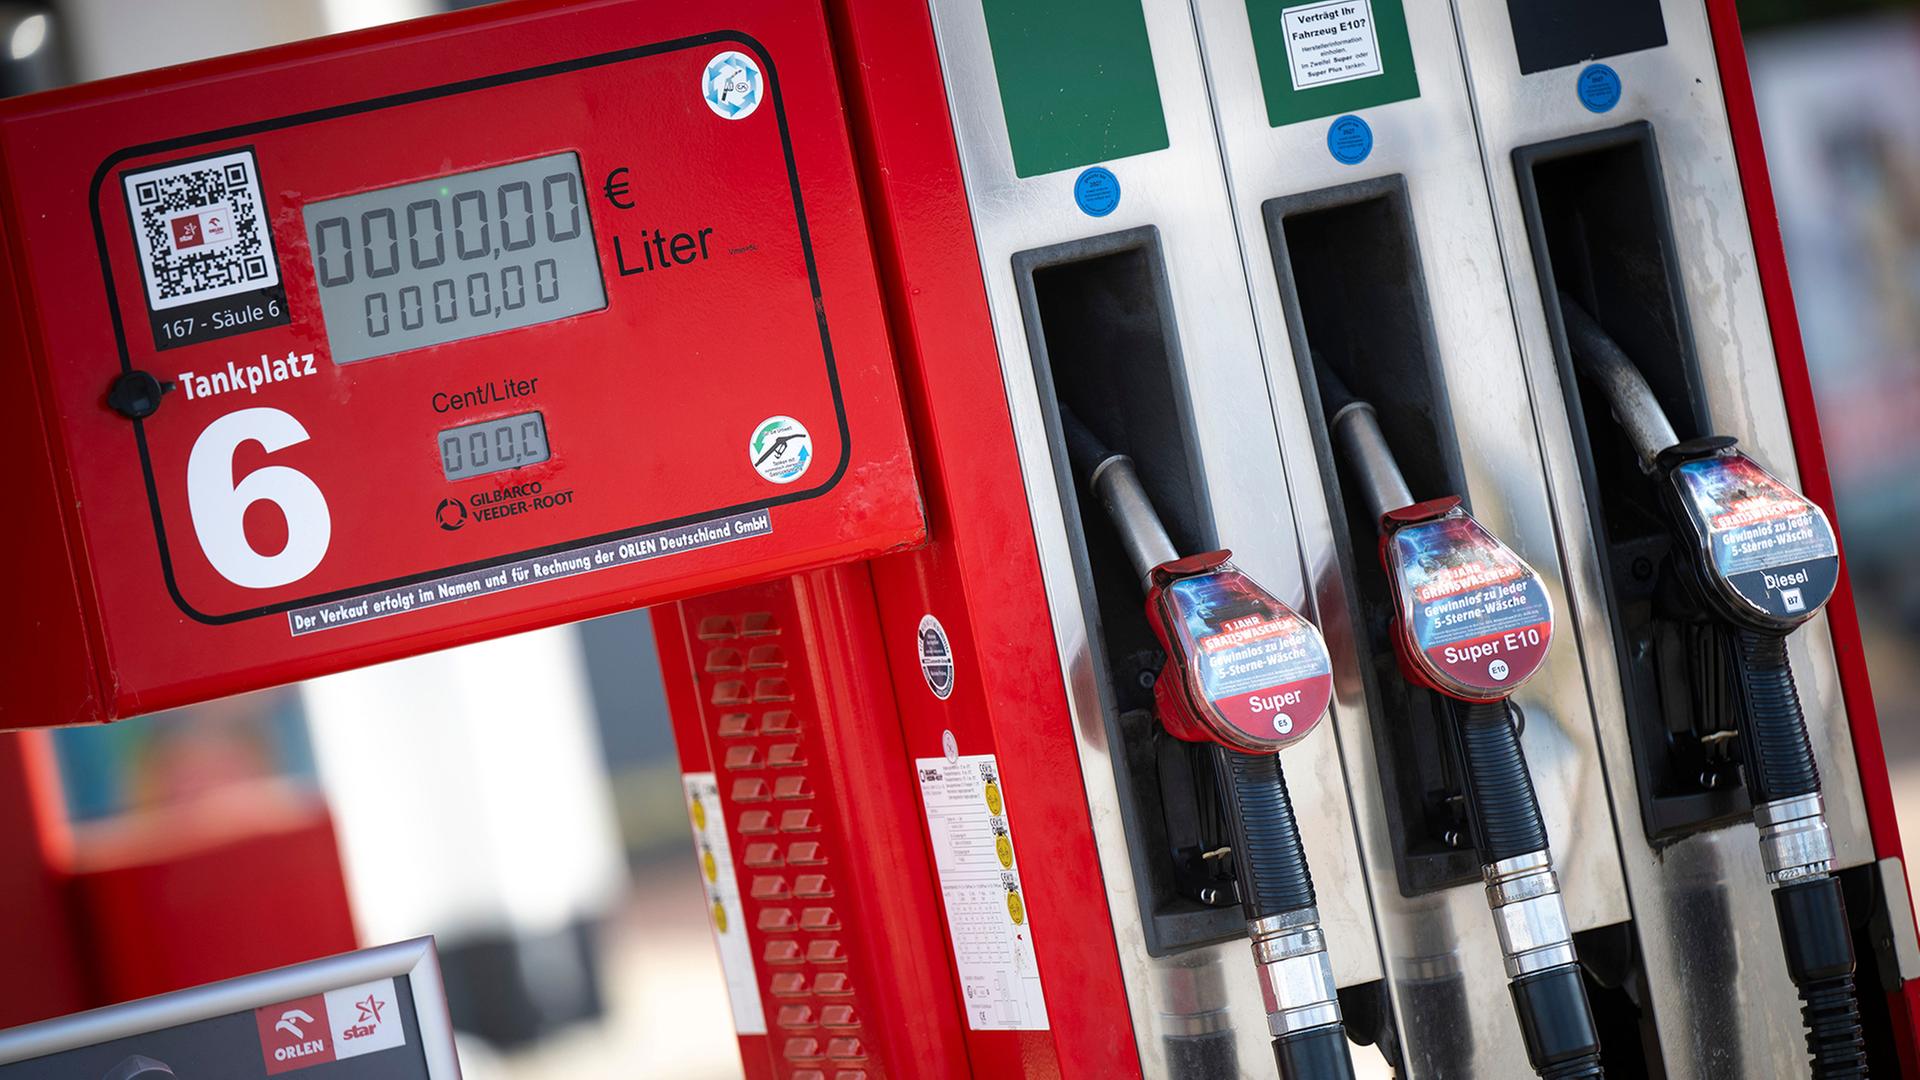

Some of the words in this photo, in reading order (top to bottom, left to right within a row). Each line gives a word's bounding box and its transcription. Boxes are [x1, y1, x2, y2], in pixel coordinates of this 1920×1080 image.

[1298, 10, 1339, 24] Verträgt
[1341, 8, 1355, 16] Ihr
[1292, 27, 1337, 40] Fahrzeug
[1340, 19, 1366, 31] E10?
[1333, 55, 1352, 63] Super
[603, 167, 635, 209] €
[316, 172, 581, 288] 0000,00
[613, 227, 713, 277] Liter
[162, 318, 195, 340] 167
[212, 305, 264, 330] Säule
[268, 300, 280, 318] 6
[179, 351, 317, 400] Tankplatz
[432, 378, 539, 413] Cent/Liter
[187, 407, 331, 589] 6
[470, 481, 542, 507] GILBARCO
[472, 491, 574, 523] VEEDER-ROOT
[1722, 524, 1773, 545] Gewinnlos
[1774, 522, 1787, 533] zu
[295, 614, 317, 630] Der
[319, 601, 368, 623] Verkauf
[373, 593, 415, 613] erfolgt
[419, 590, 434, 603] im
[437, 579, 481, 599] Namen
[485, 570, 507, 589] und
[512, 567, 530, 583] für
[534, 557, 591, 578] Rechnung
[594, 550, 615, 564] der
[618, 539, 656, 560] ORLEN
[660, 523, 731, 550] Deutschland
[735, 516, 769, 534] GmbH
[1764, 568, 1809, 589] Diesel
[1424, 592, 1482, 617] Gewinnlos
[1483, 590, 1497, 601] zu
[1434, 595, 1527, 628] 5-Sterne-Wäsche
[1224, 623, 1233, 631] 1
[1233, 616, 1261, 631] JAHR
[1209, 647, 1263, 668] Gewinnlos
[1265, 643, 1277, 652] zu
[1444, 640, 1500, 664] Super
[1504, 629, 1539, 651] E10
[1219, 648, 1306, 679] 5-Sterne-Wäsche
[1491, 665, 1506, 674] E10
[1249, 690, 1301, 712] Super
[1278, 719, 1288, 727] E5
[343, 1023, 377, 1040] star
[274, 1039, 324, 1061] ORLEN
